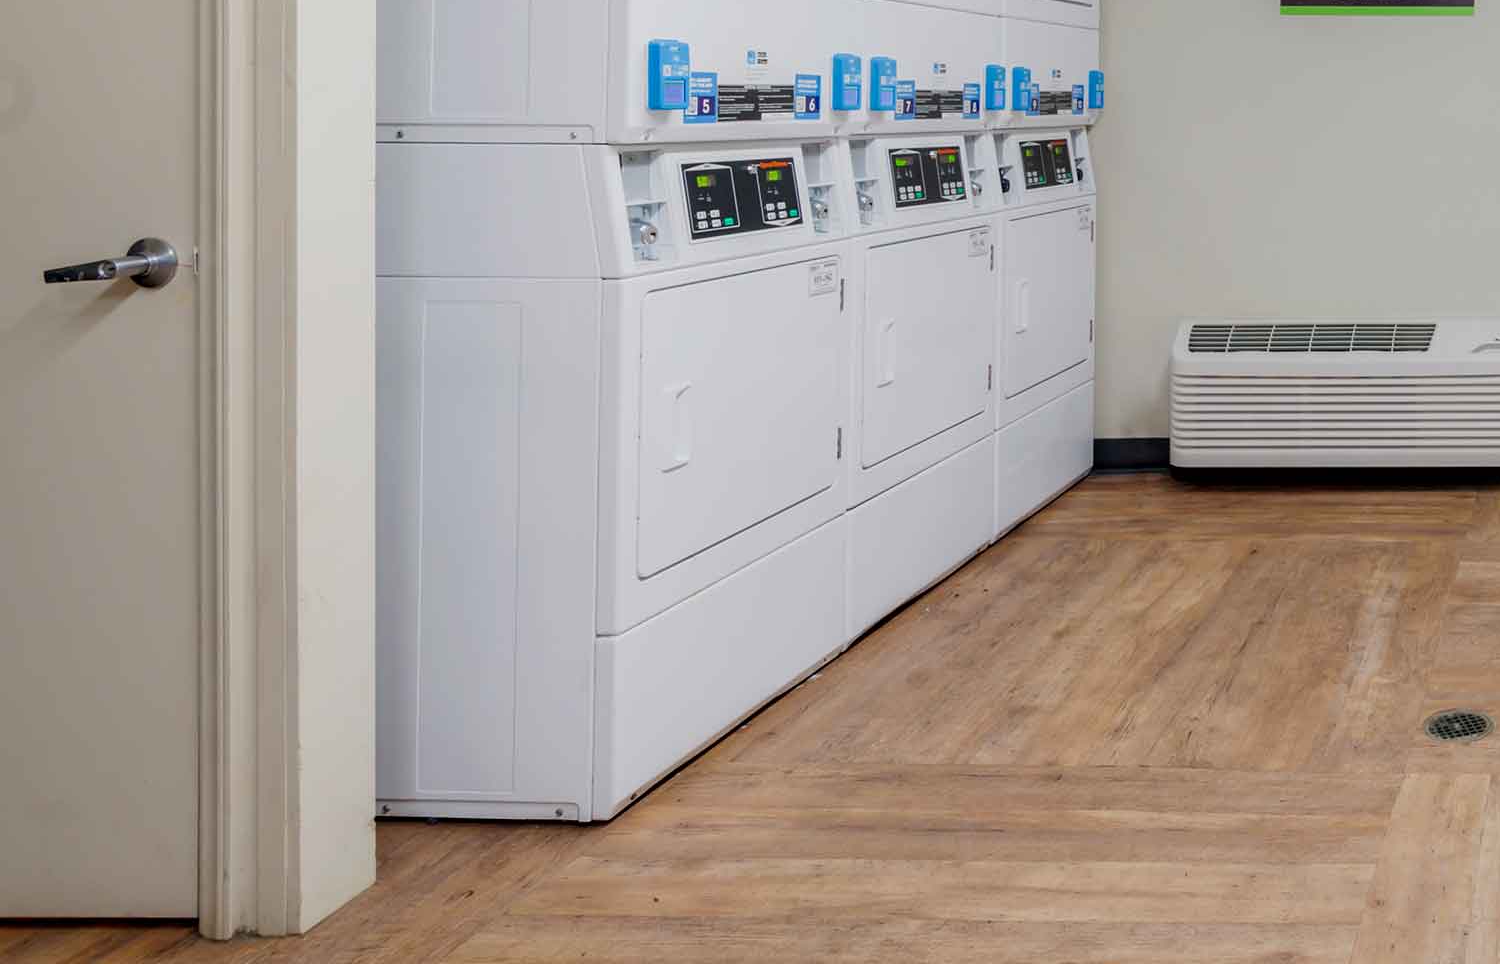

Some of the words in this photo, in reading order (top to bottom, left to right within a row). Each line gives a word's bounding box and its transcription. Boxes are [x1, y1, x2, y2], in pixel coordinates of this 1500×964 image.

[702, 99, 711, 114] 5
[808, 98, 816, 112] 6
[905, 101, 912, 112] 7
